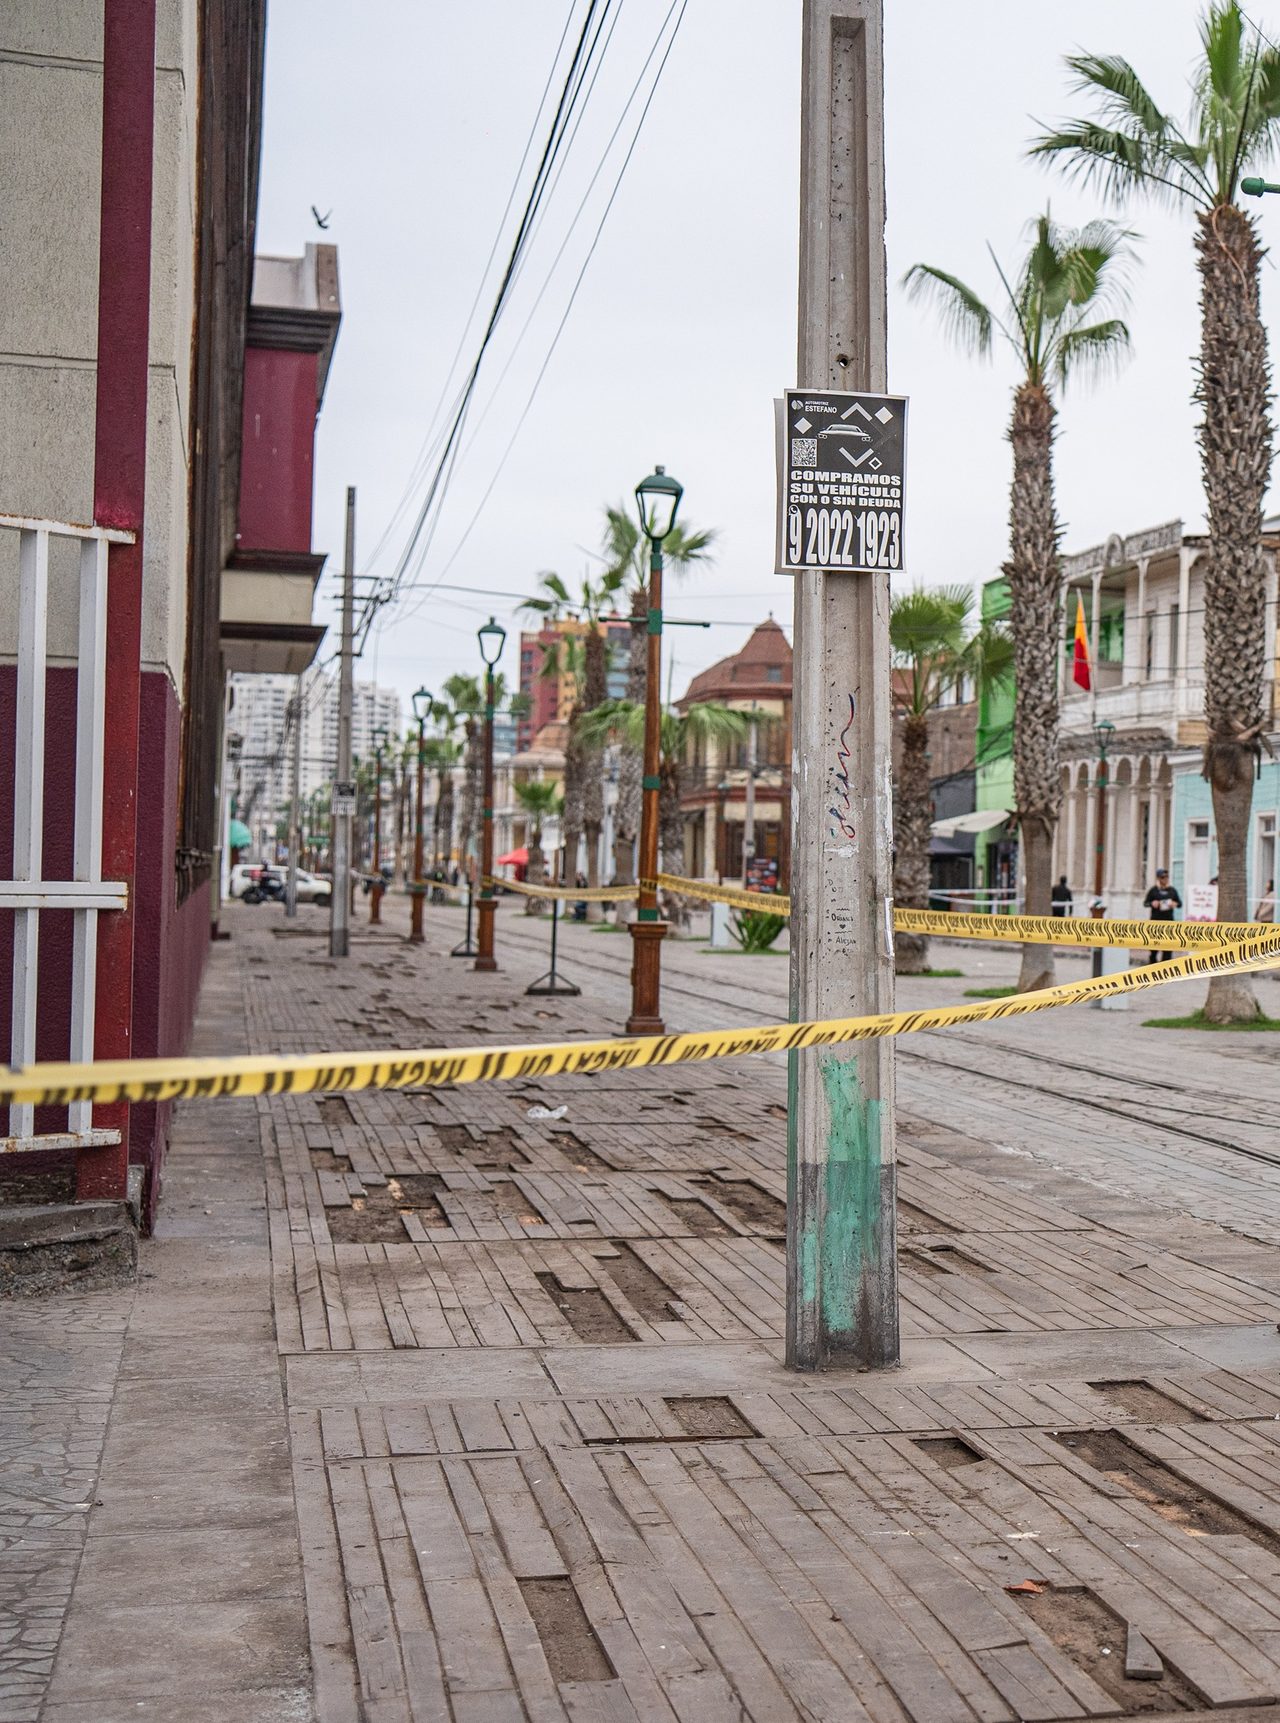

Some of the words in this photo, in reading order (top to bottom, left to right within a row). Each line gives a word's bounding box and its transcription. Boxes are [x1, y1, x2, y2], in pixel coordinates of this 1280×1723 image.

[805, 405, 837, 413] ESTEFANO
[791, 470, 901, 486] COMPRAMOS
[790, 483, 814, 494] SU
[817, 484, 901, 498] VEHÍCULO
[790, 494, 818, 504] CON
[820, 496, 830, 505] O
[833, 496, 856, 506] SIN
[859, 498, 901, 508] DEUDA
[789, 507, 802, 564] 9
[806, 508, 853, 565] 2022
[856, 510, 900, 569] 1923
[1248, 944, 1259, 957] NO
